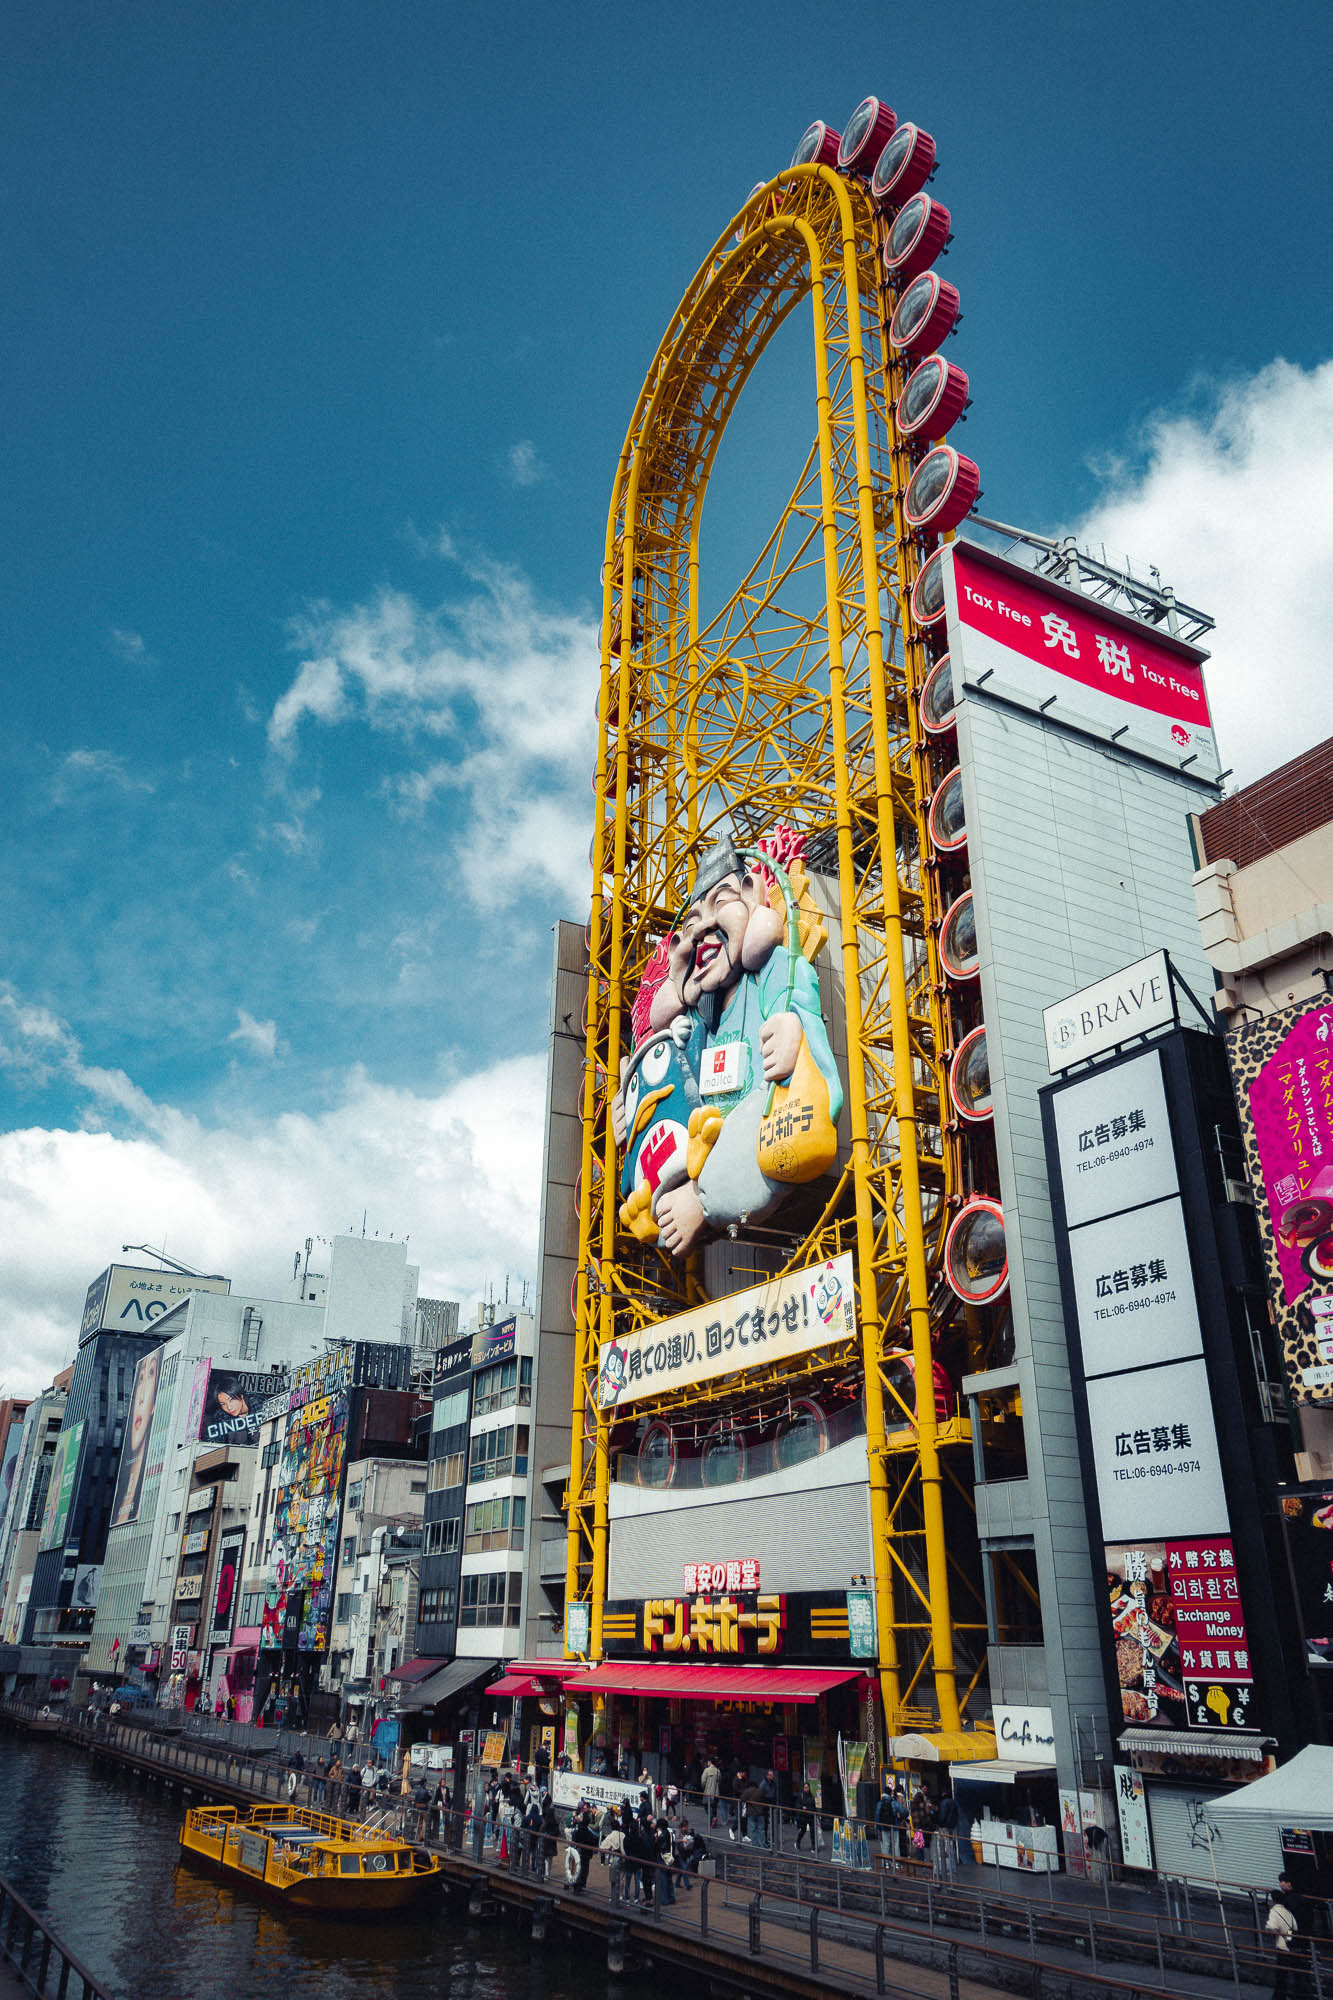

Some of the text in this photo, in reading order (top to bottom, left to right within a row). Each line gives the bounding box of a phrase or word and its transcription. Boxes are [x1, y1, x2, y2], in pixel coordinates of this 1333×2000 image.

[964, 585, 1200, 701] Tax Free 免税 Tax Free
[1080, 976, 1163, 1036] BRAVE
[1296, 1058, 1323, 1157] マダムシンコといえば
[1078, 1109, 1147, 1152] 広告募集
[1076, 1137, 1154, 1173] TEL:06-6940-4974
[1095, 1258, 1168, 1298] 広告募集
[1093, 1291, 1177, 1321] TEL:06-6940-4974
[1115, 1423, 1192, 1457] 広告募集
[1113, 1460, 1201, 1481] TEL:06-6940-4974
[683, 1558, 760, 1594] 驚安の殿堂
[1169, 1549, 1235, 1569] 外幣兌換
[1173, 1577, 1239, 1600] 외화환전
[1177, 1609, 1231, 1623] Exchange
[1206, 1624, 1244, 1638] Money
[172, 1627, 188, 1669] 伝串 50
[1182, 1650, 1249, 1669] 外貨両替
